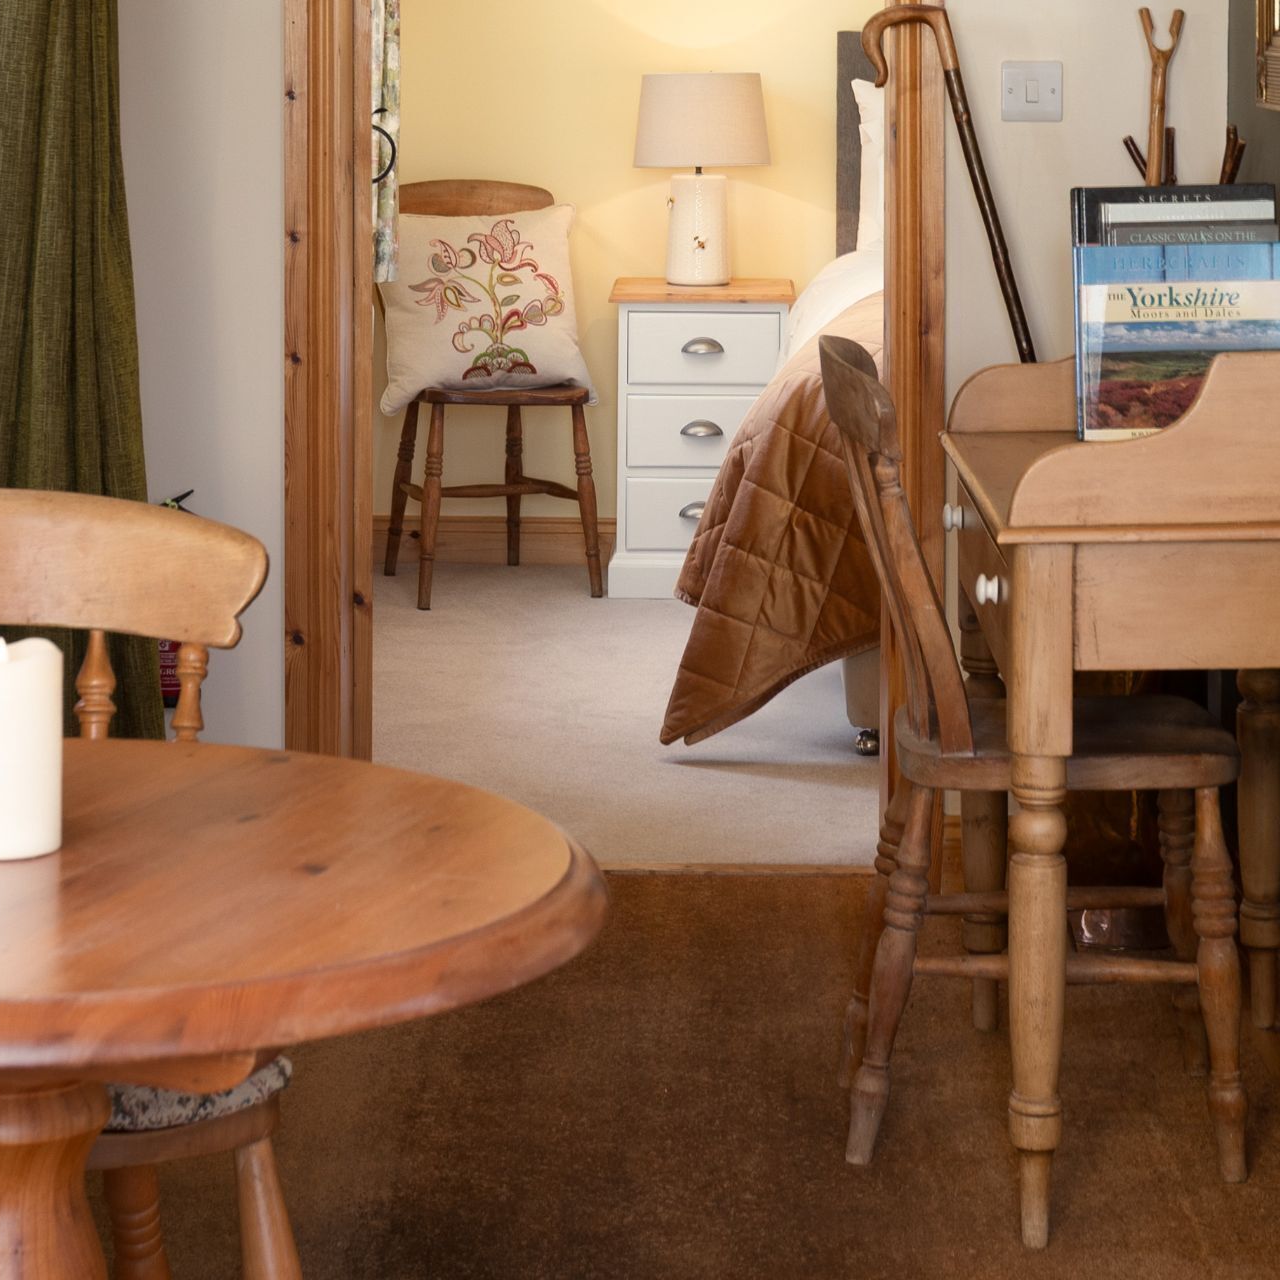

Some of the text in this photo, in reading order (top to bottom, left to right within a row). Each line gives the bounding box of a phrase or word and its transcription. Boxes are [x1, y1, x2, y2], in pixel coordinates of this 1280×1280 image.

[1138, 194, 1212, 203] SECRETS
[1130, 231, 1256, 243] CLASSIC WALKS ON THE
[1126, 286, 1241, 308] Yorkshire
[1131, 307, 1241, 319] Moors and Dales
